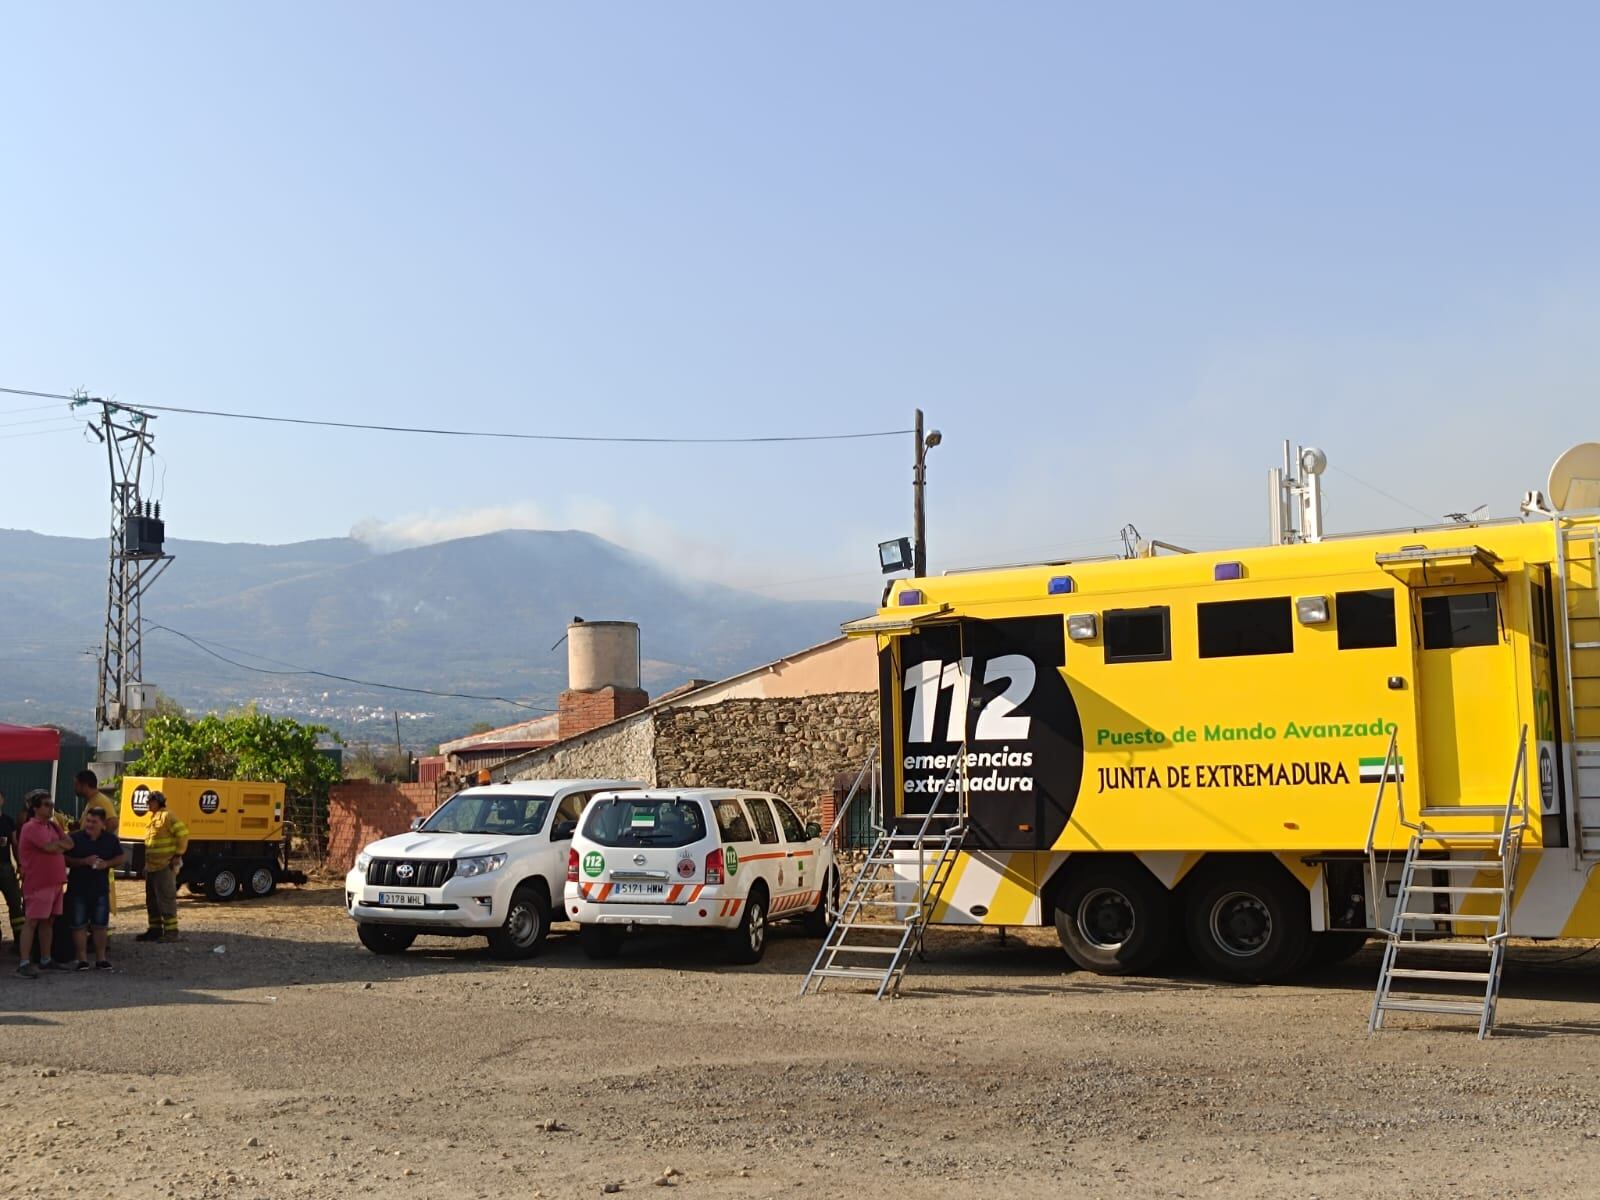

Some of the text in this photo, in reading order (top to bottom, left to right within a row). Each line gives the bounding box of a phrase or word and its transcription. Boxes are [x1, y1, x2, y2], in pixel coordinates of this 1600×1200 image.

[903, 654, 1037, 743] 112
[1097, 718, 1398, 746] Puesto de Mando Avanzado
[1541, 758, 1551, 783] 112
[903, 769, 1033, 793] extremadura
[1097, 762, 1350, 794] JUNTA DE EXTREMADURA
[133, 790, 150, 804] 112
[202, 794, 217, 805] 112
[585, 855, 602, 867] 112
[727, 850, 736, 864] 112
[622, 883, 642, 893] 5171
[385, 894, 405, 904] 2178
